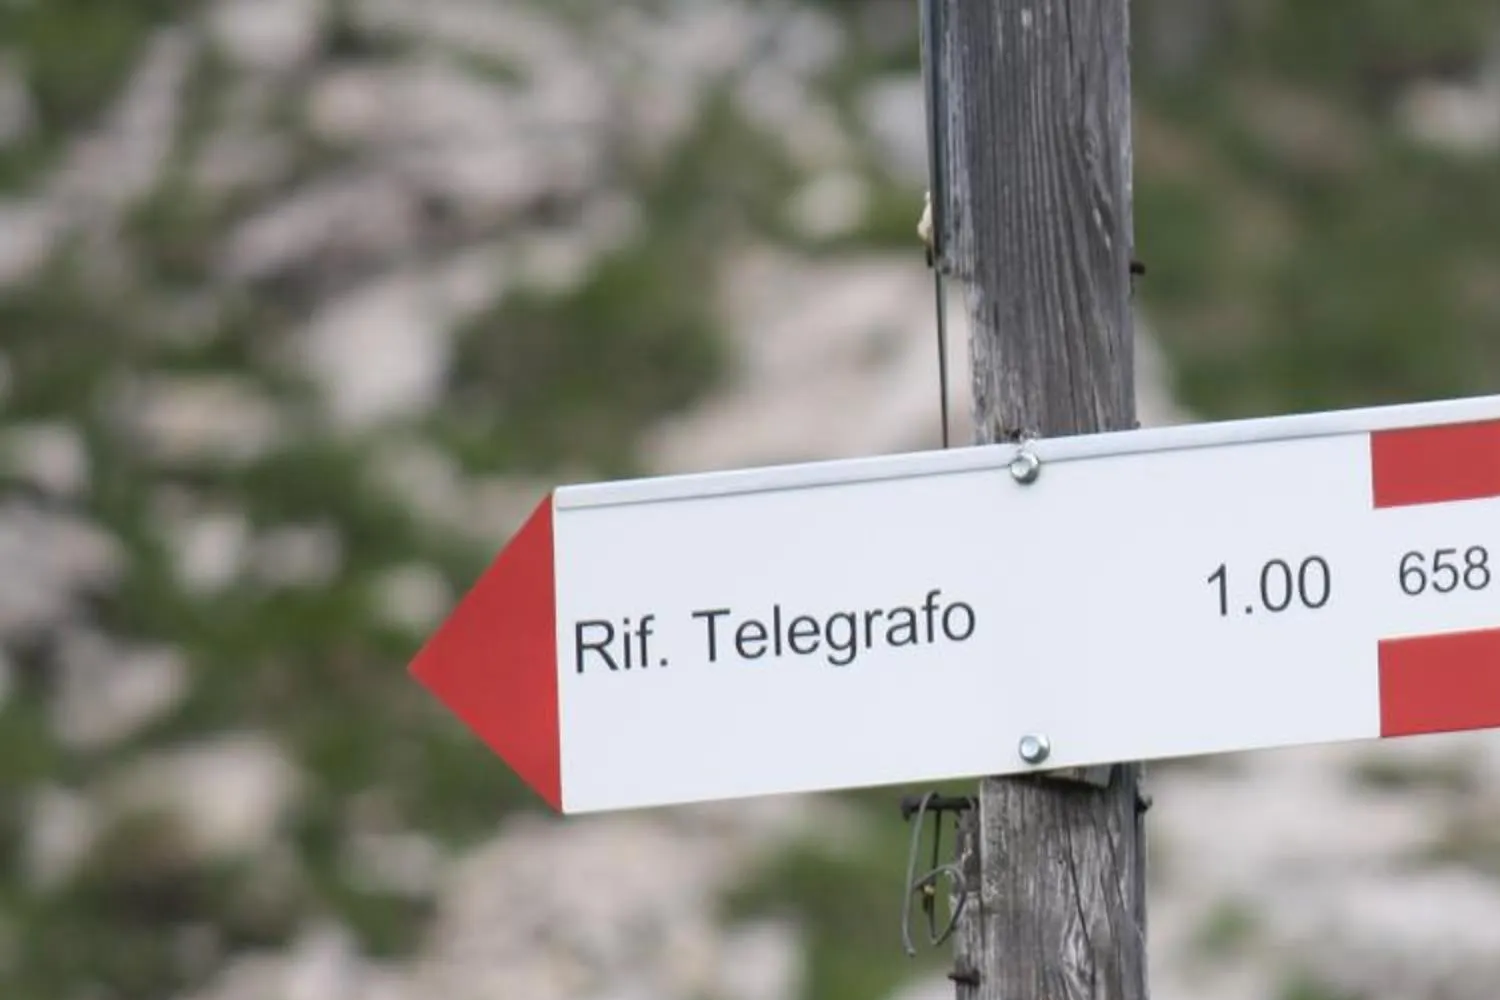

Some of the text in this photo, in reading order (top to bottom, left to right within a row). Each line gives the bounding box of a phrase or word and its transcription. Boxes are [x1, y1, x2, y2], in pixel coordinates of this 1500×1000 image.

[1398, 545, 1491, 596] 658
[575, 555, 1332, 674] Rif. Telegrafo 1.00
